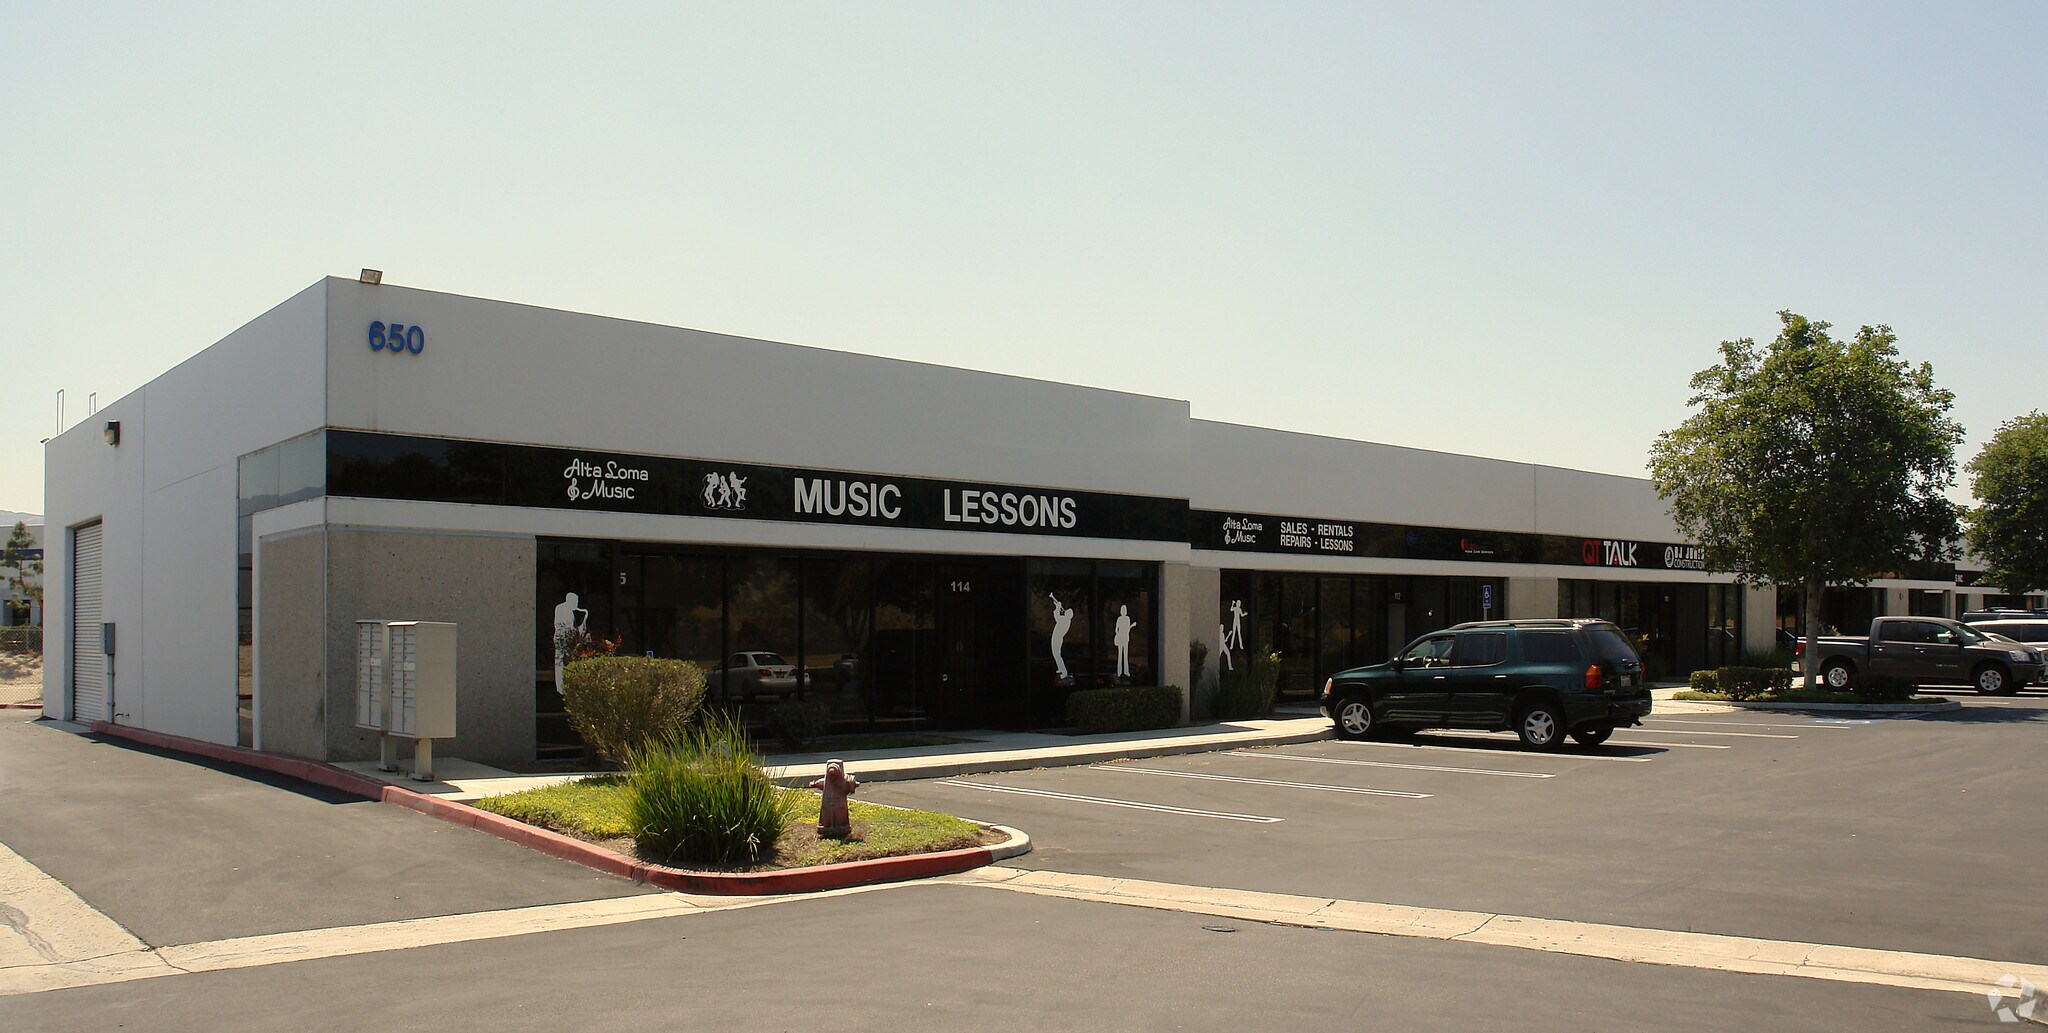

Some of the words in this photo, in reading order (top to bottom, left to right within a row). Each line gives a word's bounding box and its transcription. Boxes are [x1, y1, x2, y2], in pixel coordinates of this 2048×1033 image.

[368, 320, 425, 355] 650
[563, 457, 602, 479] Alta
[604, 460, 649, 481] Loma
[793, 476, 902, 520] MUSIC
[943, 488, 1078, 529] LESSONS
[1222, 517, 1241, 530] Alta
[1242, 517, 1263, 531] Loma
[1280, 521, 1308, 535] SALES
[1317, 524, 1354, 537] RENTALS
[1280, 535, 1312, 548] REPAIRS
[1320, 538, 1354, 552] LESSONS
[1583, 540, 1601, 565] QT
[1603, 540, 1637, 567] TALK
[619, 572, 627, 585] 5
[950, 580, 971, 593] 114
